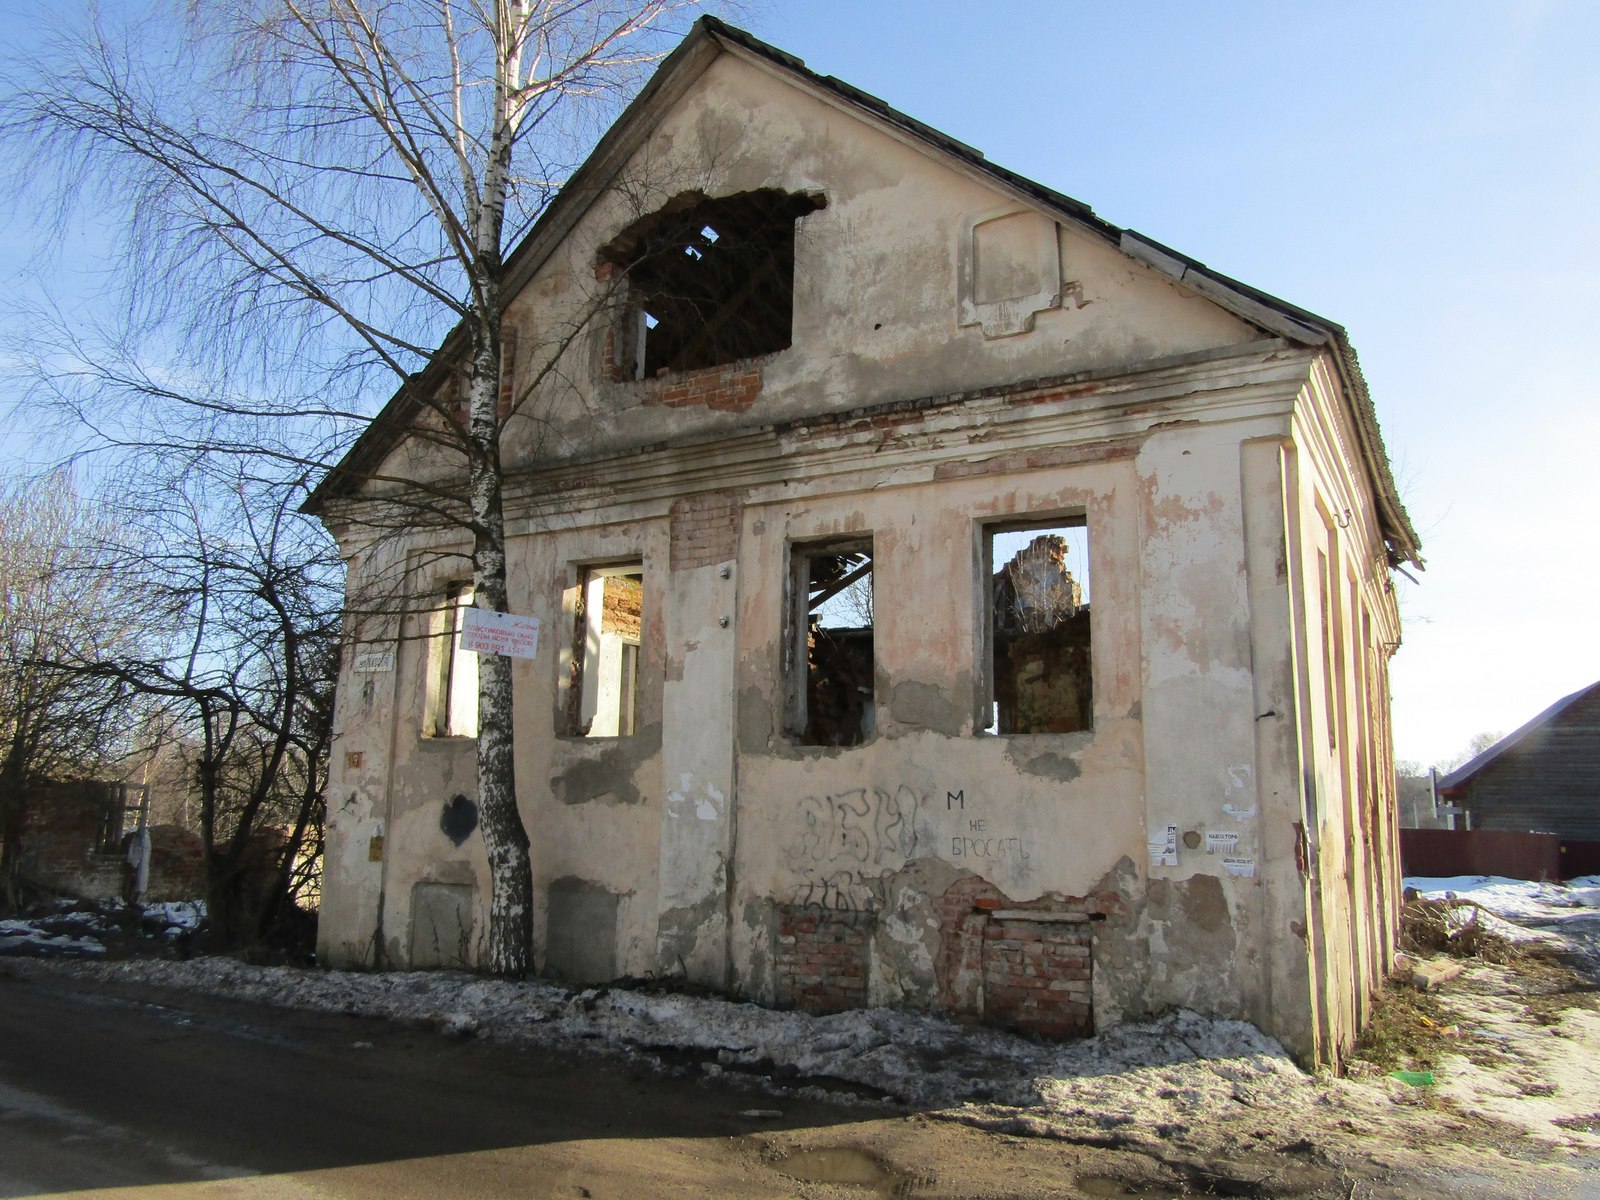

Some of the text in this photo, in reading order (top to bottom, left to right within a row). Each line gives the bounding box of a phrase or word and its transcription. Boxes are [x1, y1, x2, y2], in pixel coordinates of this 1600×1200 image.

[475, 642, 490, 650] 903
[969, 819, 987, 832] НЕ
[952, 836, 1031, 859] БРОСАТЬ
